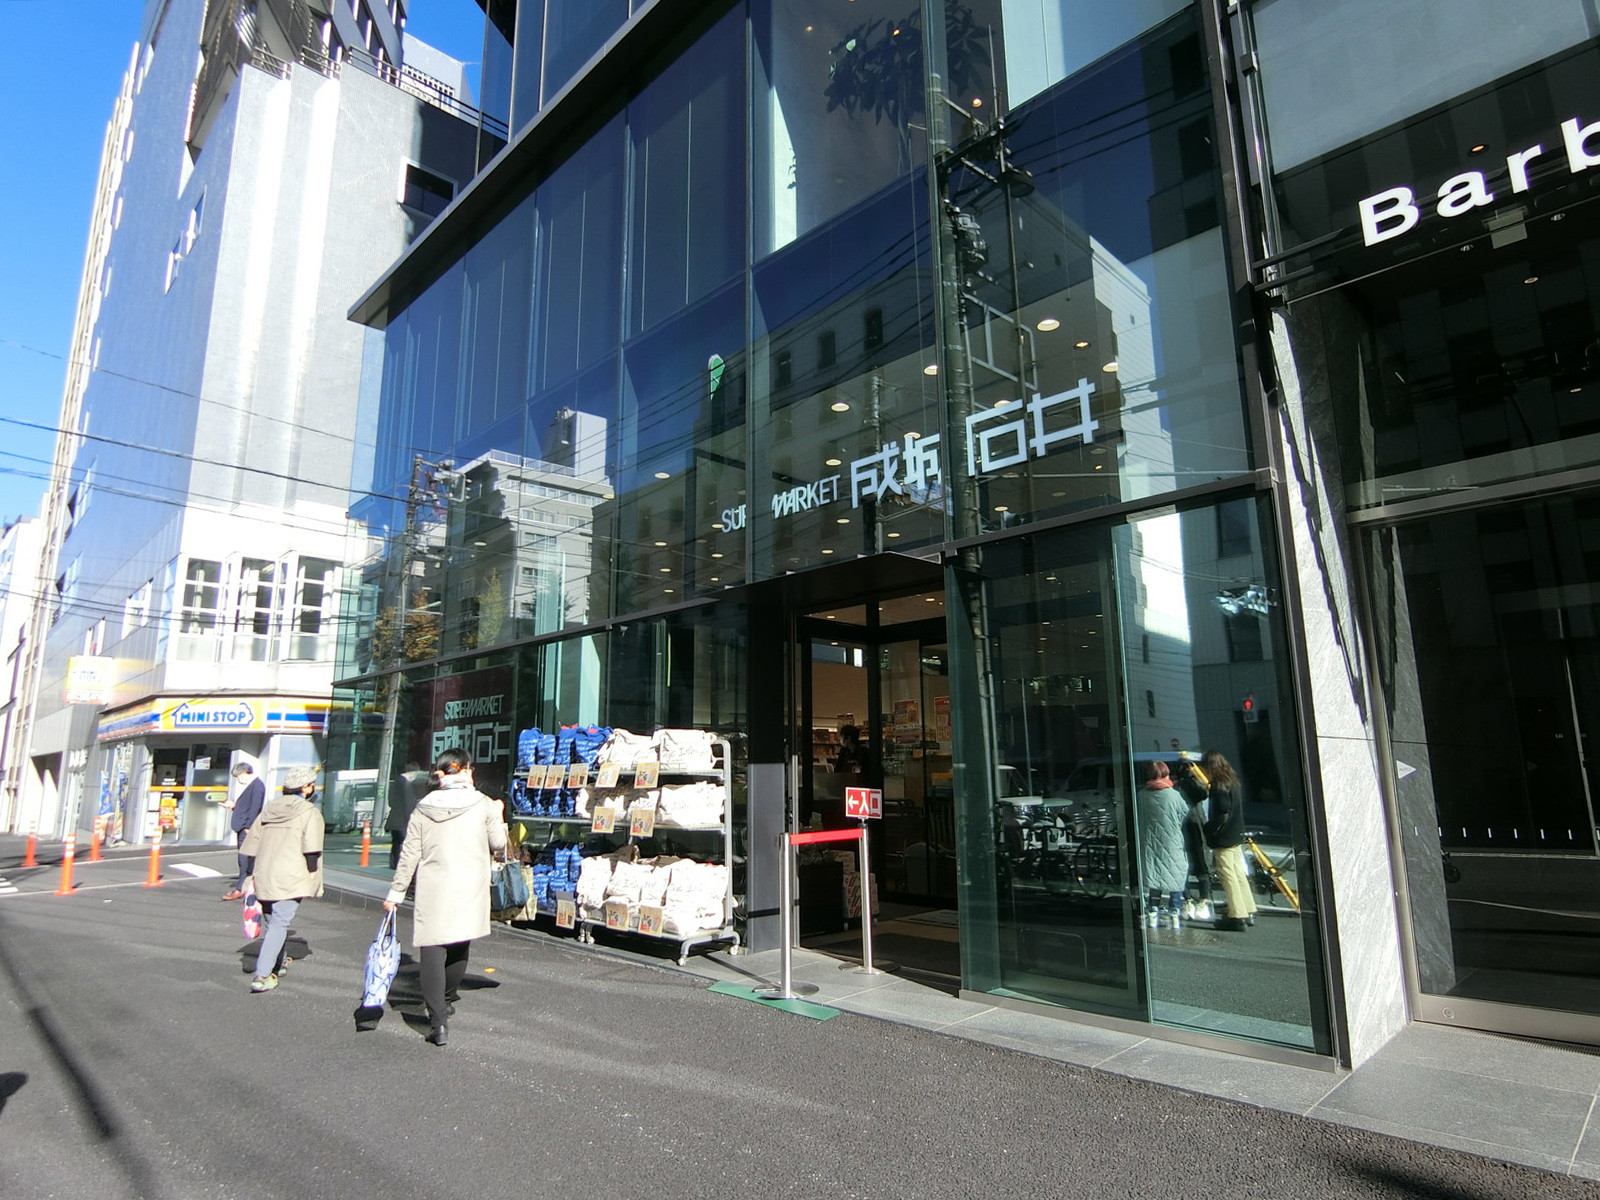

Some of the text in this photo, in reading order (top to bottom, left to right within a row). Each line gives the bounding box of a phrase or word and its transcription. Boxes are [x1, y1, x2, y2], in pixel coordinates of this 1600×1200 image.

[1358, 115, 1600, 248] Barb
[180, 711, 247, 723] MINI STOP
[444, 694, 504, 720] SUPERMARKET
[858, 791, 879, 816] 入口
